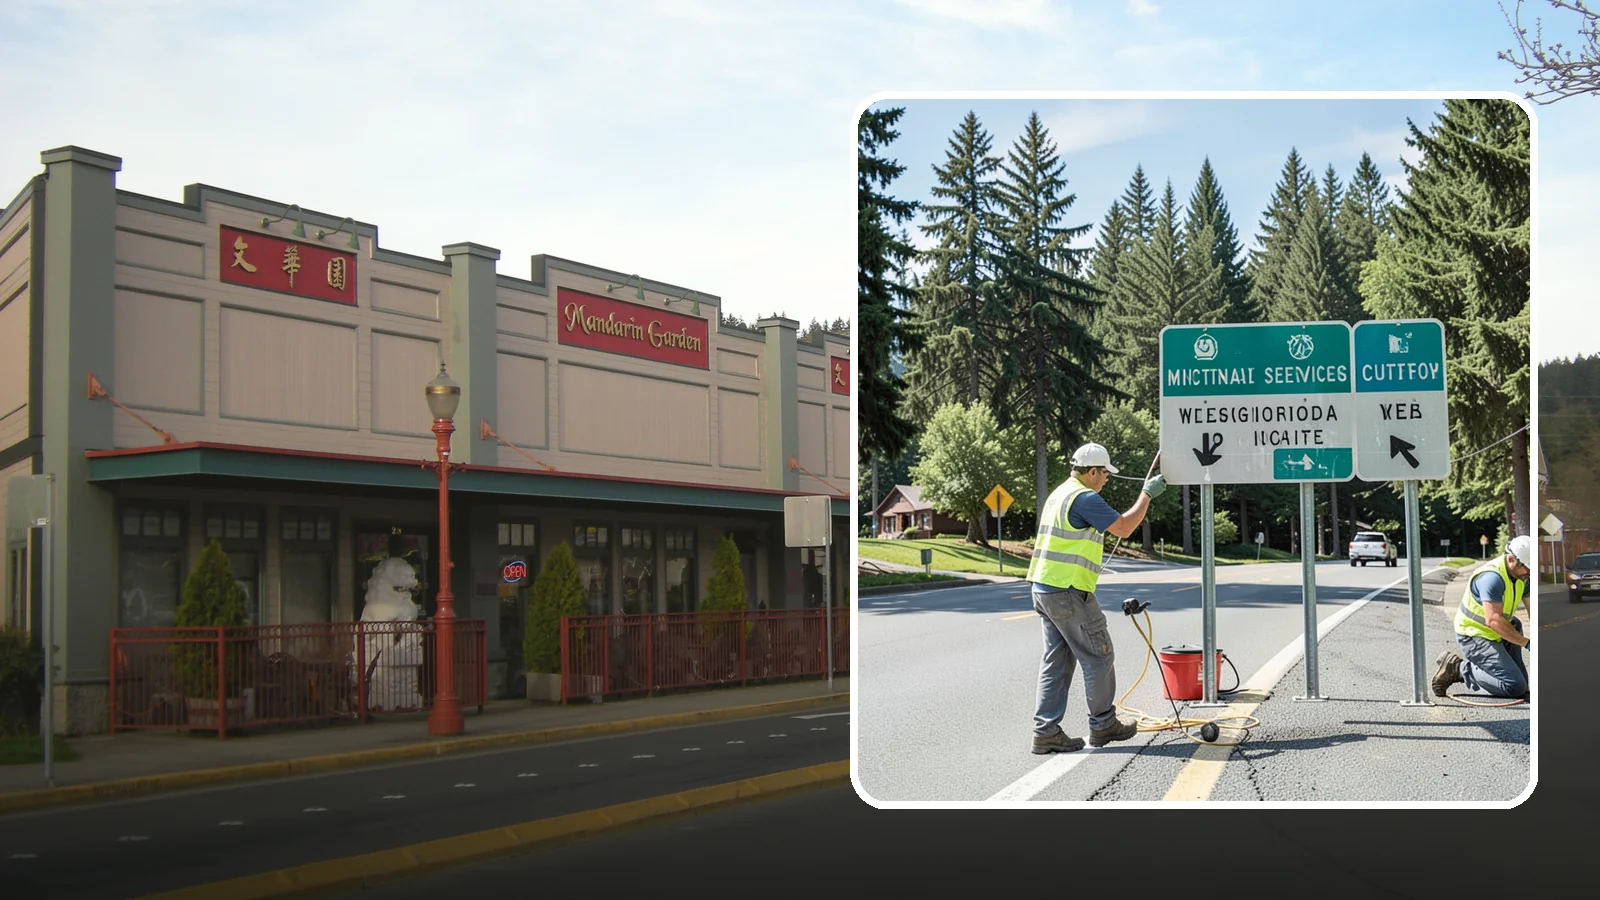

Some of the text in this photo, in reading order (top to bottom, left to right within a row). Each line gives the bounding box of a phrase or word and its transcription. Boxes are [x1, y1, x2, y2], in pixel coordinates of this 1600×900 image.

[231, 236, 346, 290] 文華園
[564, 302, 701, 352] Mandarin Garden
[503, 565, 527, 578] OPEN
